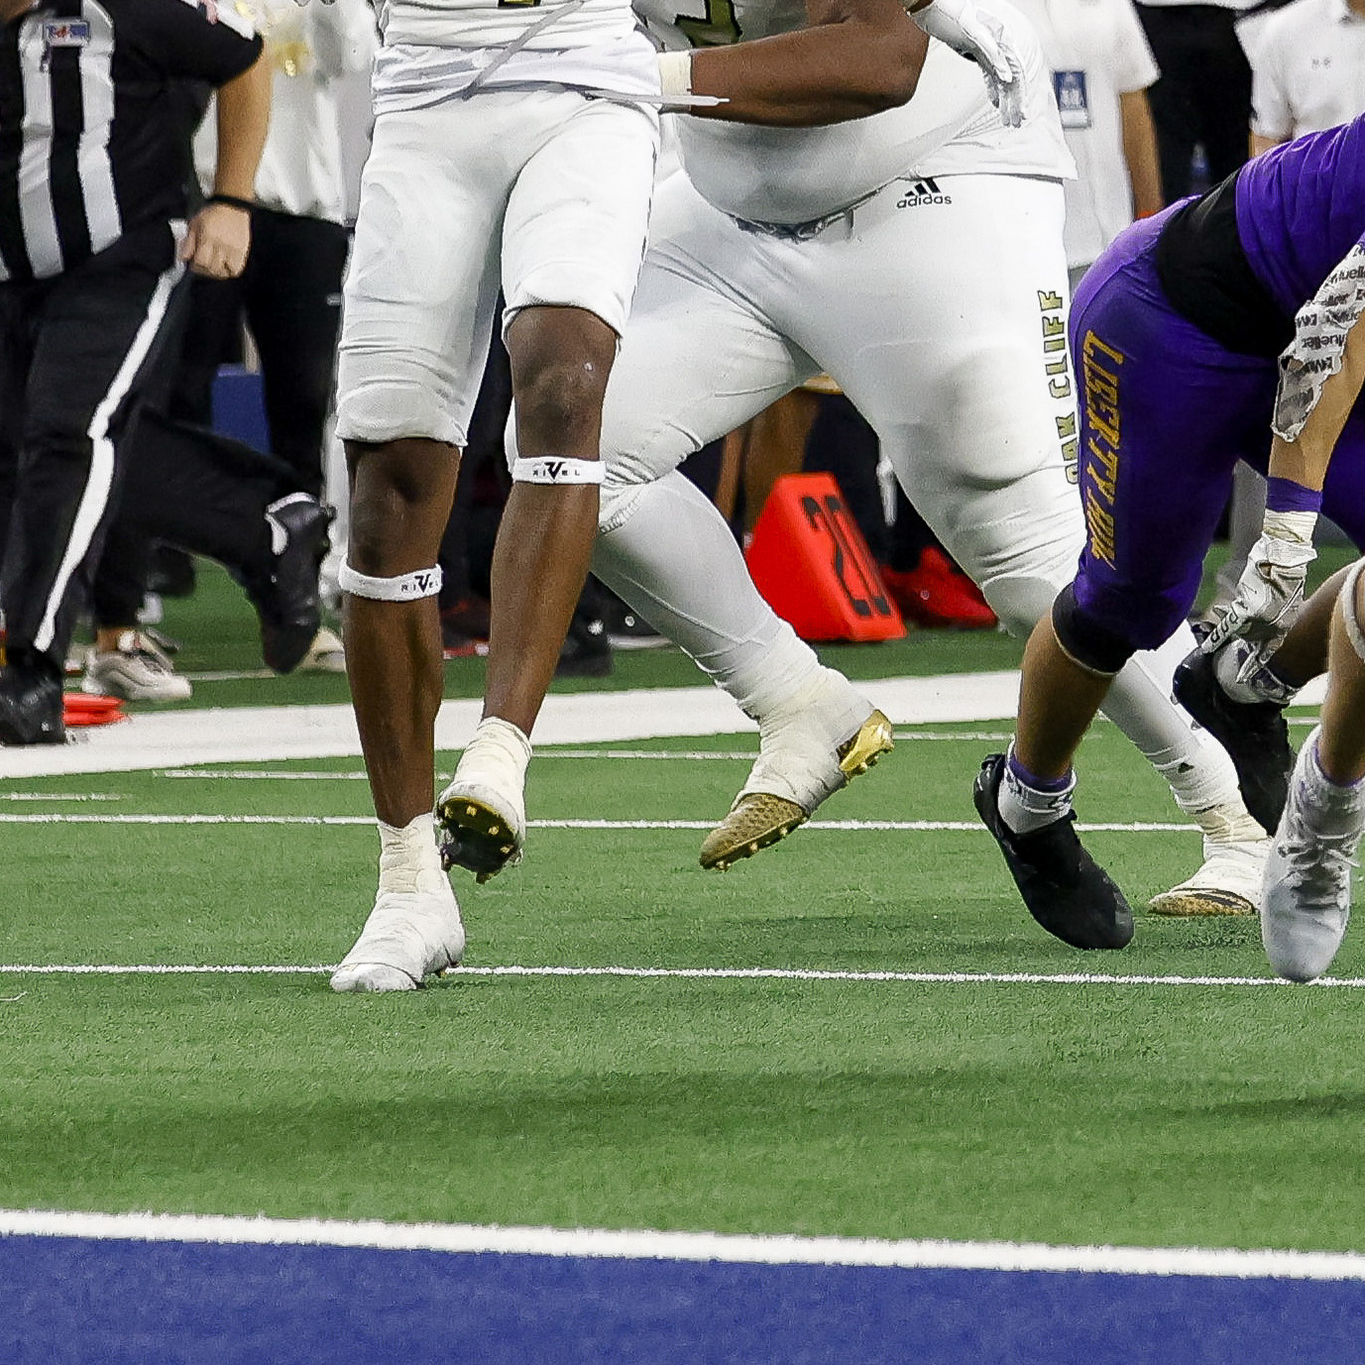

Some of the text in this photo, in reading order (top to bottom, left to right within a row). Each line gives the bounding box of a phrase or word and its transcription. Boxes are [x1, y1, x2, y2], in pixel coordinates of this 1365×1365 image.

[896, 194, 953, 209] adidas
[1037, 290, 1080, 485] OAK CLIFF
[1081, 329, 1125, 505] LIBERTY
